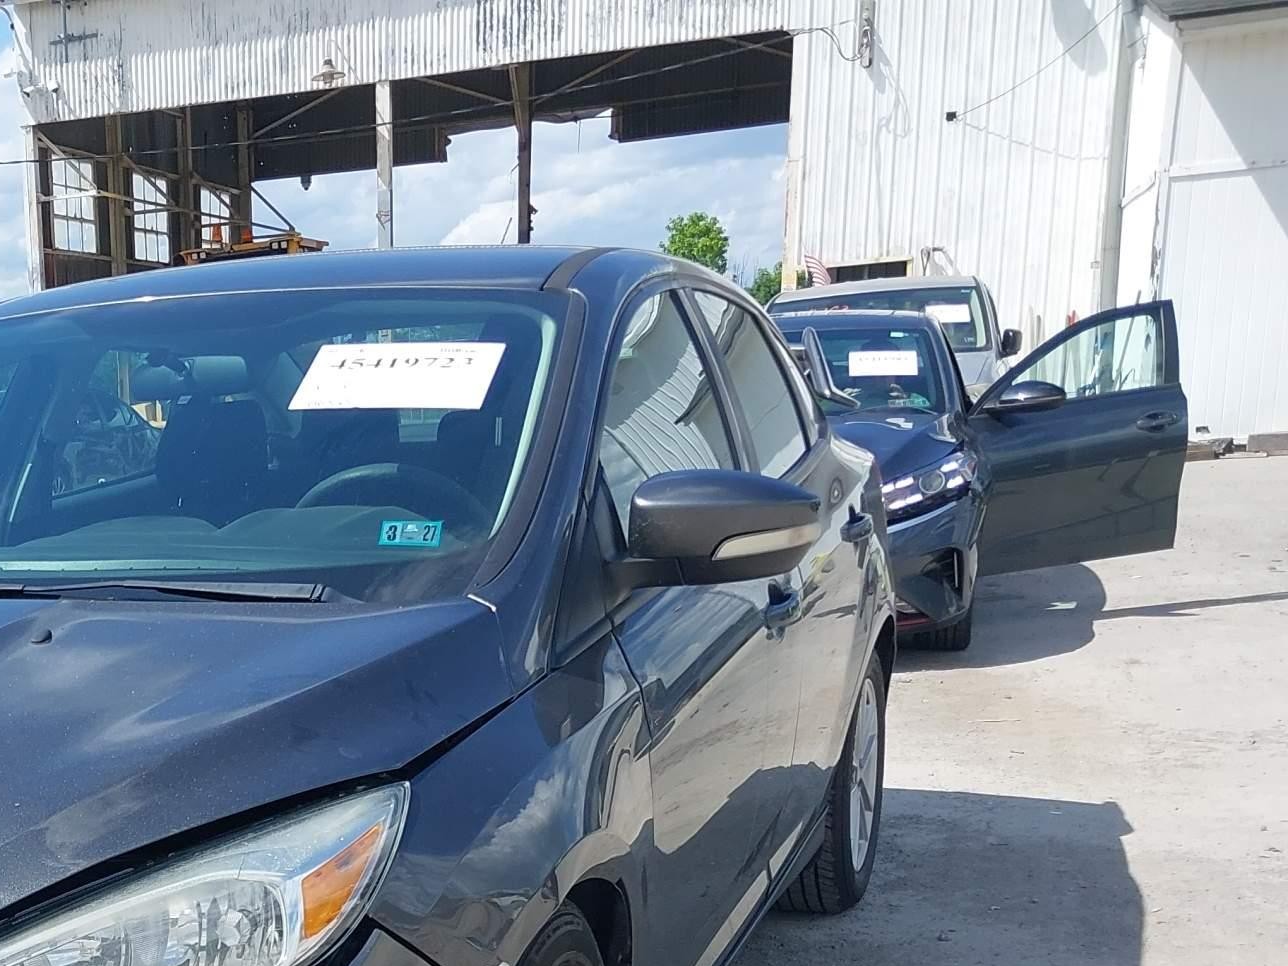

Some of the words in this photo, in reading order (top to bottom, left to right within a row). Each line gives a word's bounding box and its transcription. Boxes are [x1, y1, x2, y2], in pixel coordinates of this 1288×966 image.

[329, 357, 475, 370] 45419723
[386, 524, 398, 542] 3
[422, 524, 438, 542] 27
